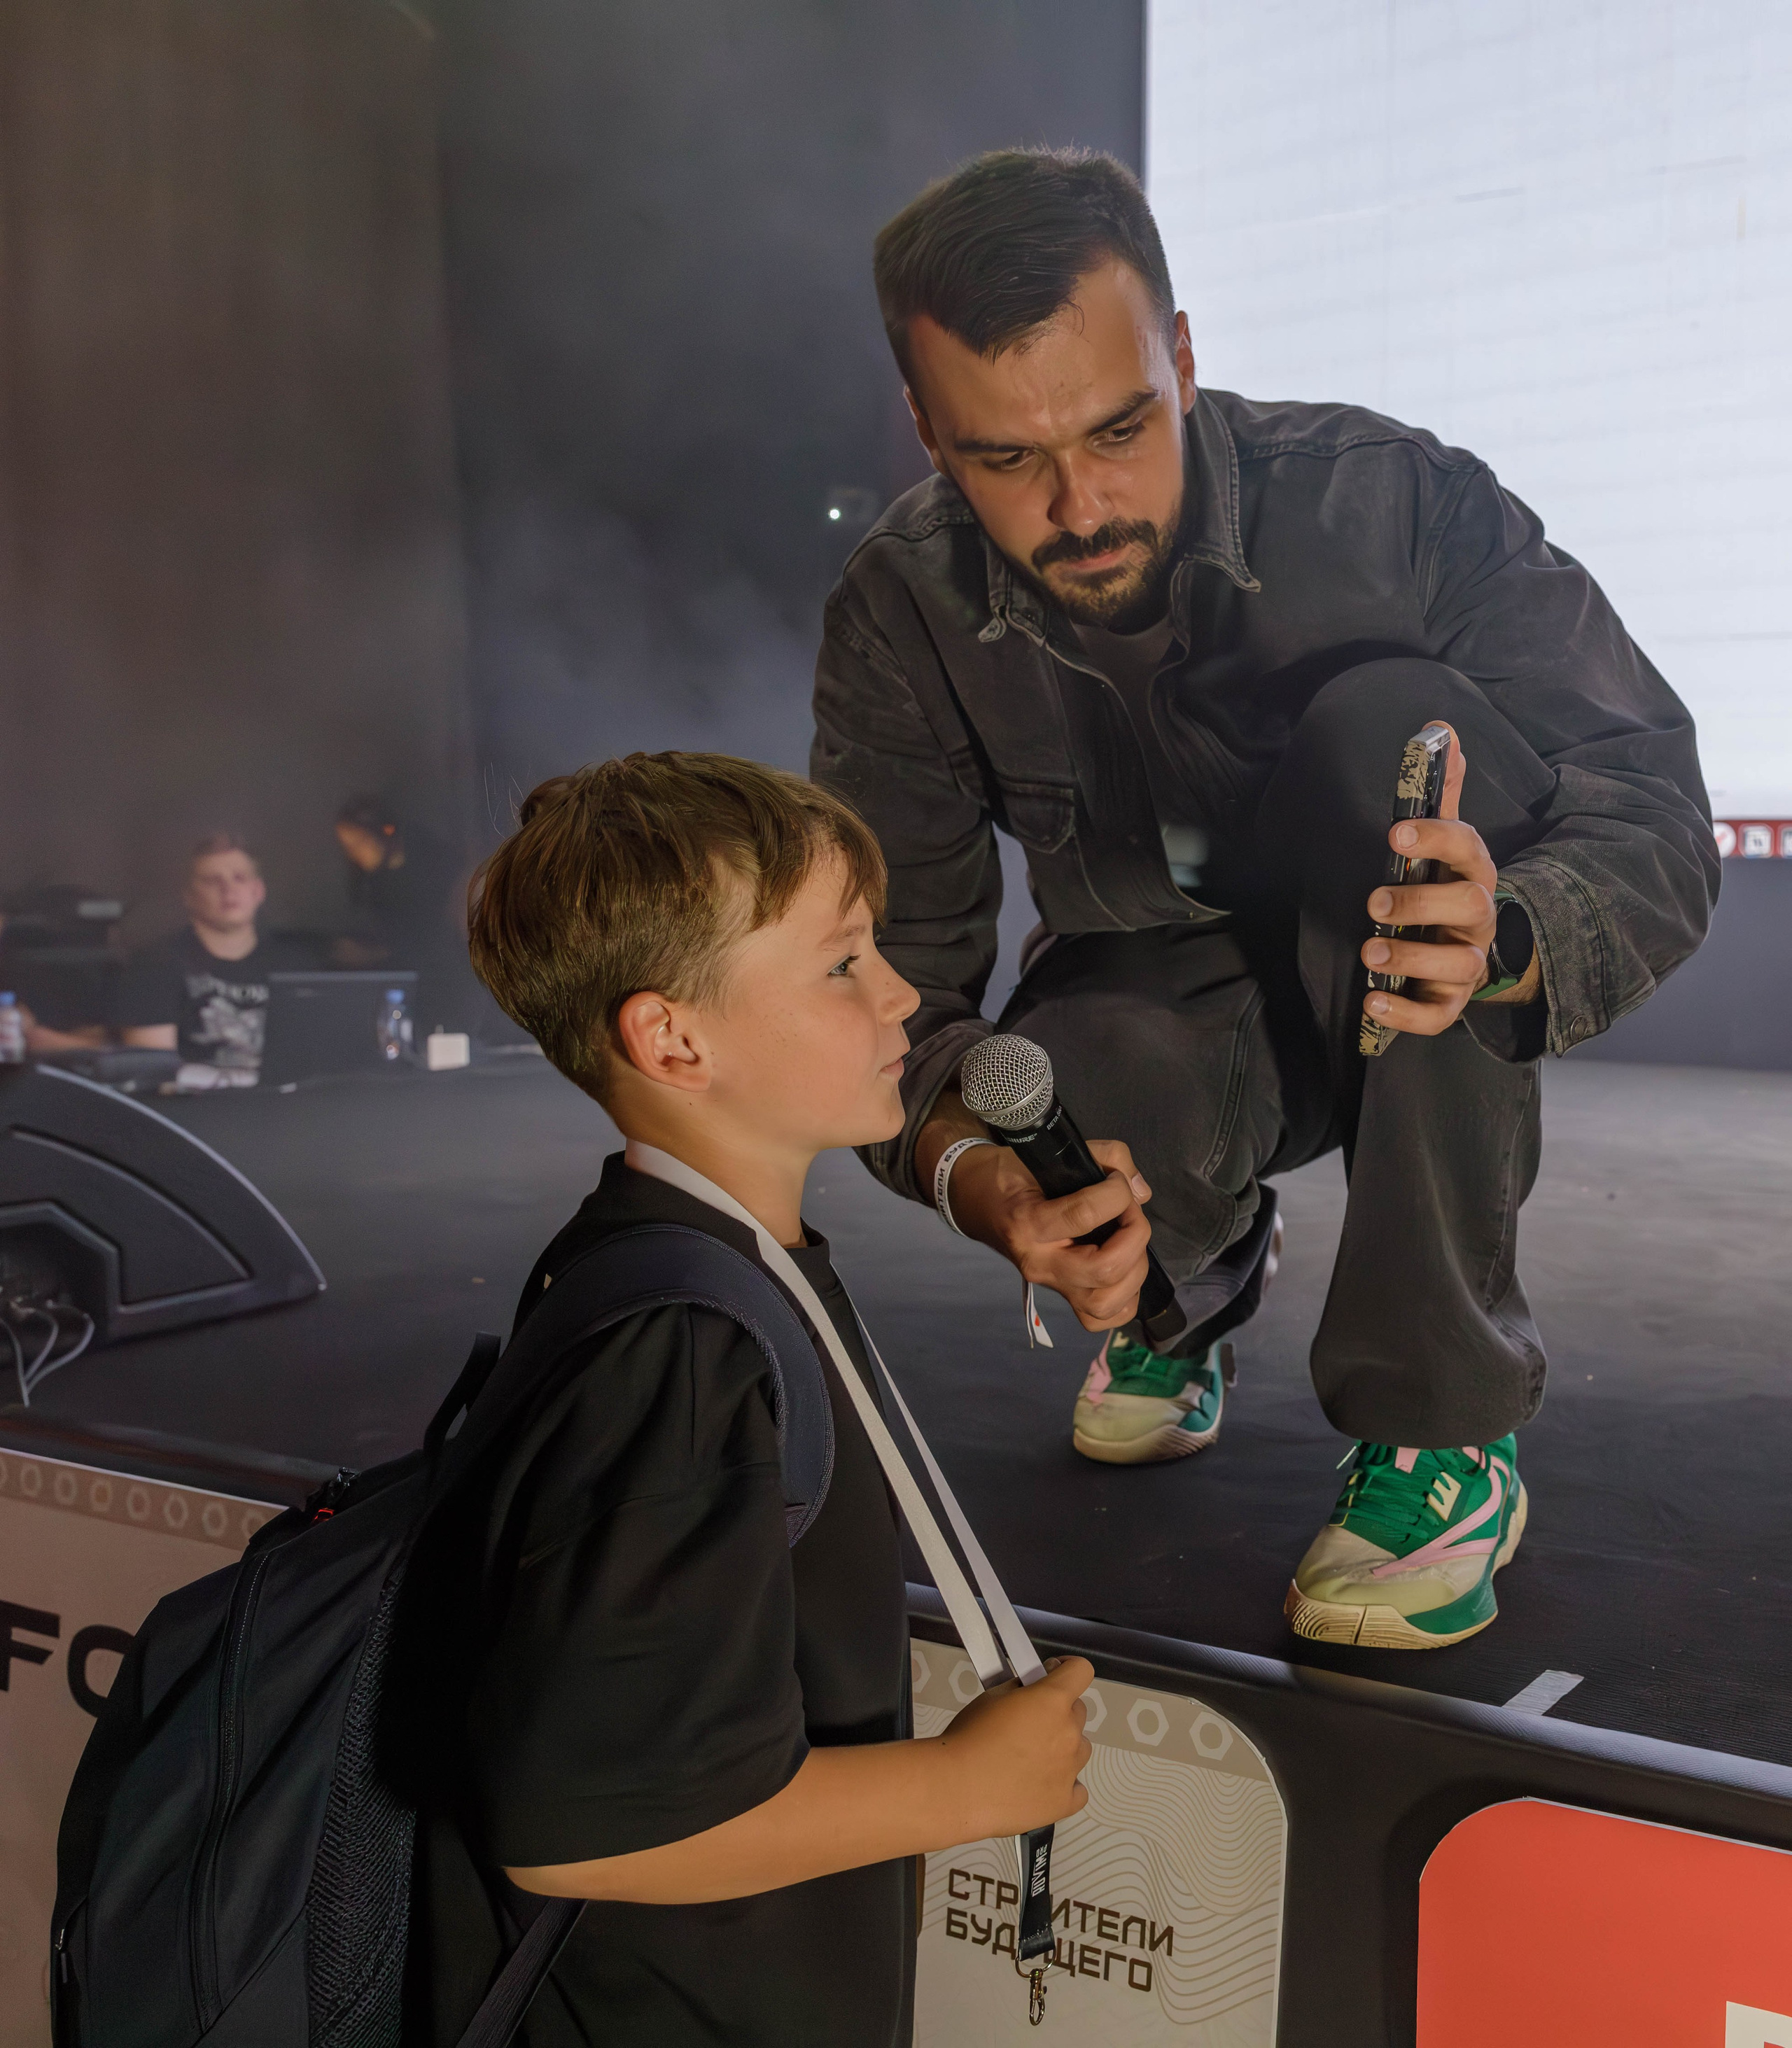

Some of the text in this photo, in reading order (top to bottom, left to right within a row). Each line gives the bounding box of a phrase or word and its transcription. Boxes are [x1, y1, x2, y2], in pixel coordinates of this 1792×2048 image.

[1046, 1116, 1059, 1130] BETA
[946, 1907, 1152, 1993] БУДЩЕГО
[948, 1868, 1174, 1957] СТРИТЕЛИ
